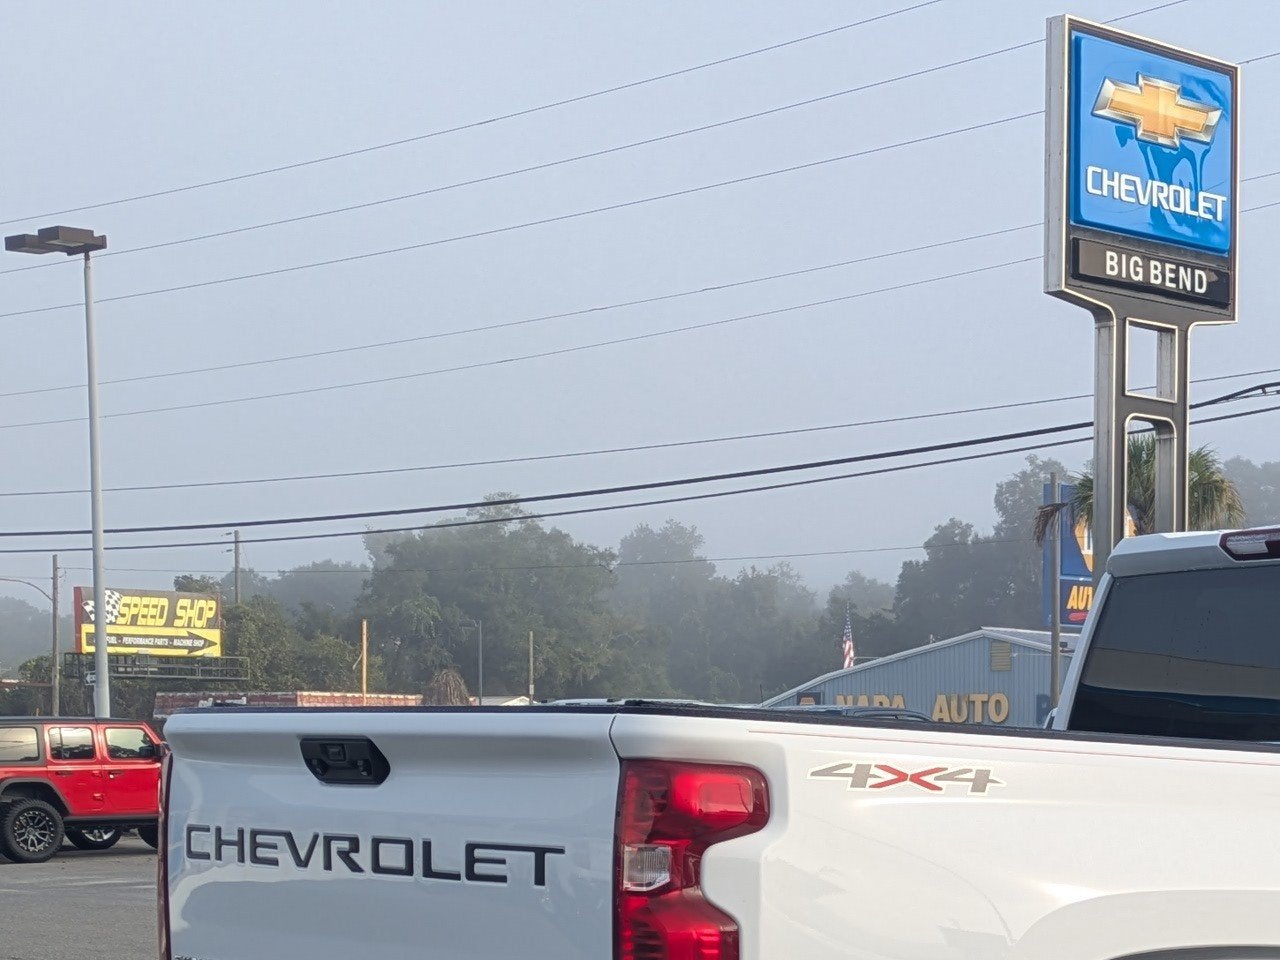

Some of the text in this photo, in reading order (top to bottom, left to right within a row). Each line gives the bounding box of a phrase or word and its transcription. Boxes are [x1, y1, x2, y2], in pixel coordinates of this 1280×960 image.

[1086, 165, 1227, 222] CHEVROLET
[1105, 251, 1207, 294] BIG BEND
[115, 595, 217, 629] SPEED SHOP
[931, 692, 1009, 724] AUTO
[185, 823, 566, 887] CHEVROLET
